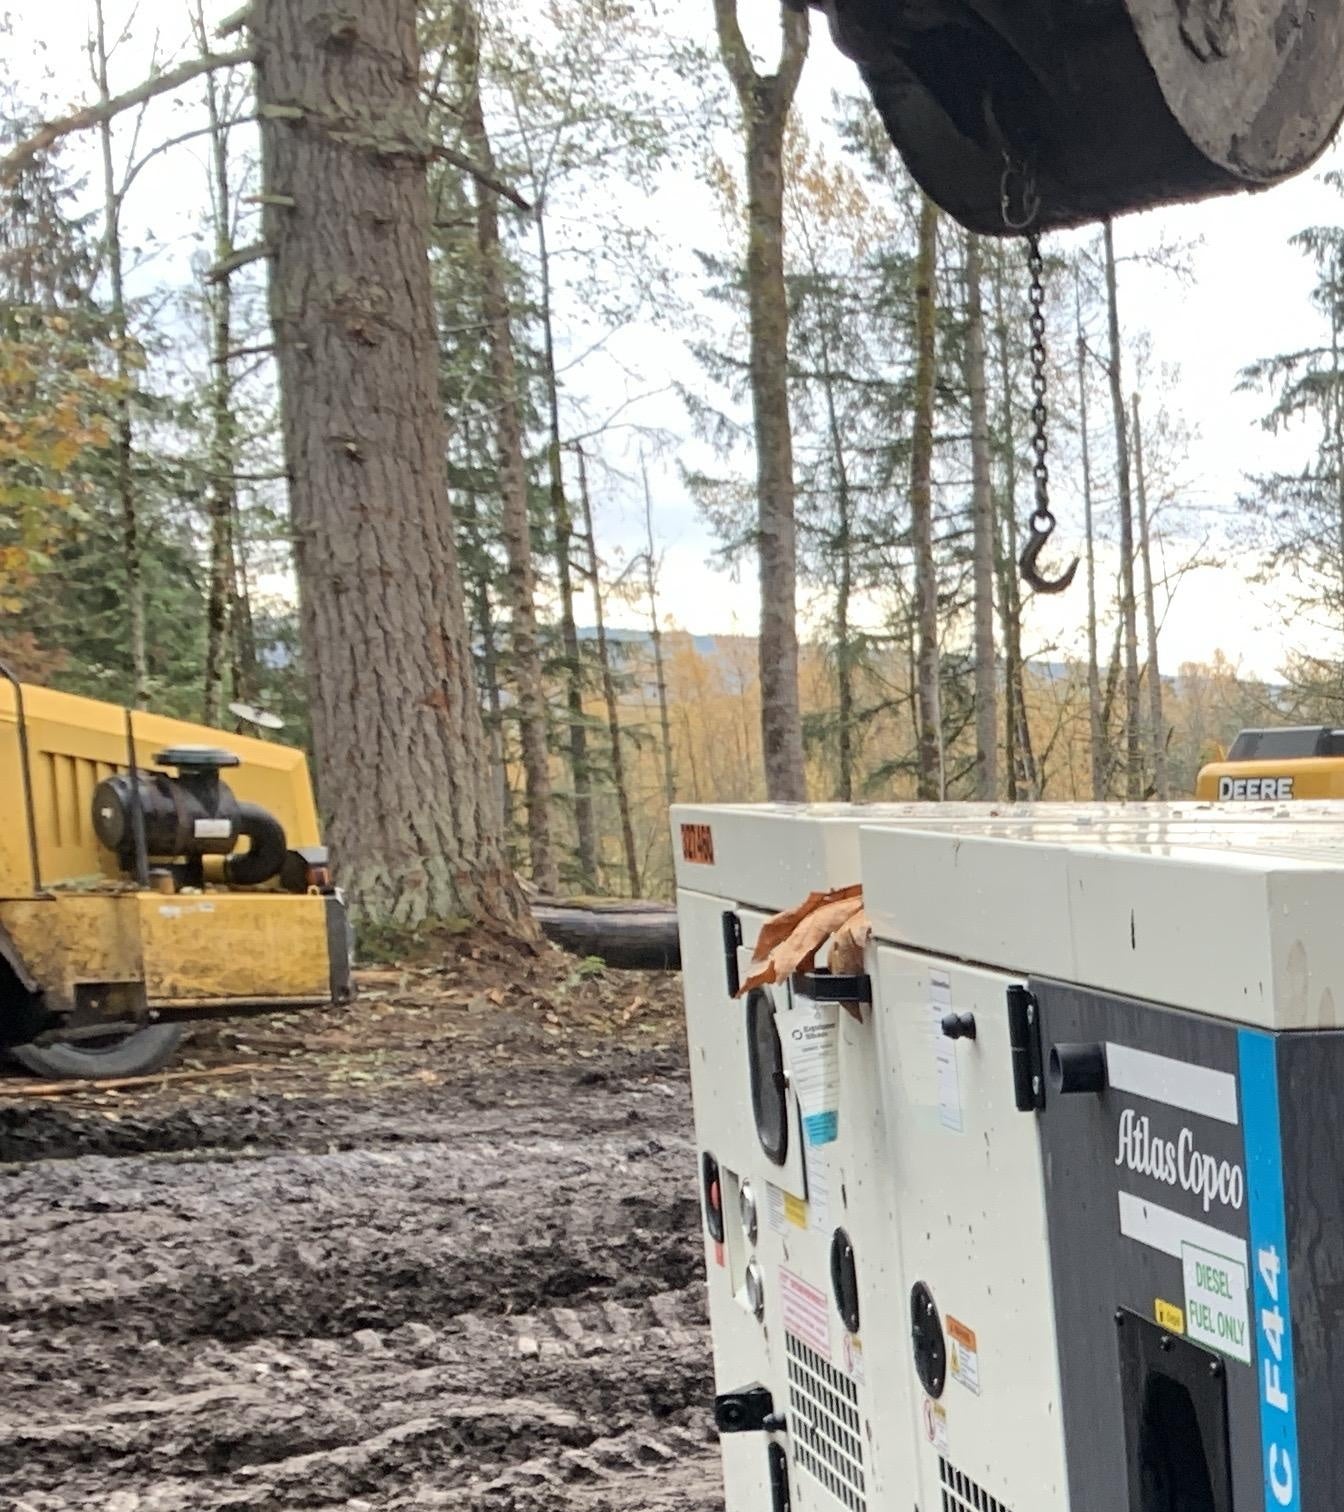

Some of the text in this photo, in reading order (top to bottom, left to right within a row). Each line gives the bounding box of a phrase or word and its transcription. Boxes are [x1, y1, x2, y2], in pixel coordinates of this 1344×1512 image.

[1219, 776, 1293, 801] DEERE
[1114, 1108, 1243, 1212] Atlas Copco
[1196, 1261, 1233, 1300] DIESEL
[1190, 1299, 1216, 1334] FUEL
[1217, 1311, 1246, 1346] ONLY
[1257, 1245, 1290, 1414] F44
